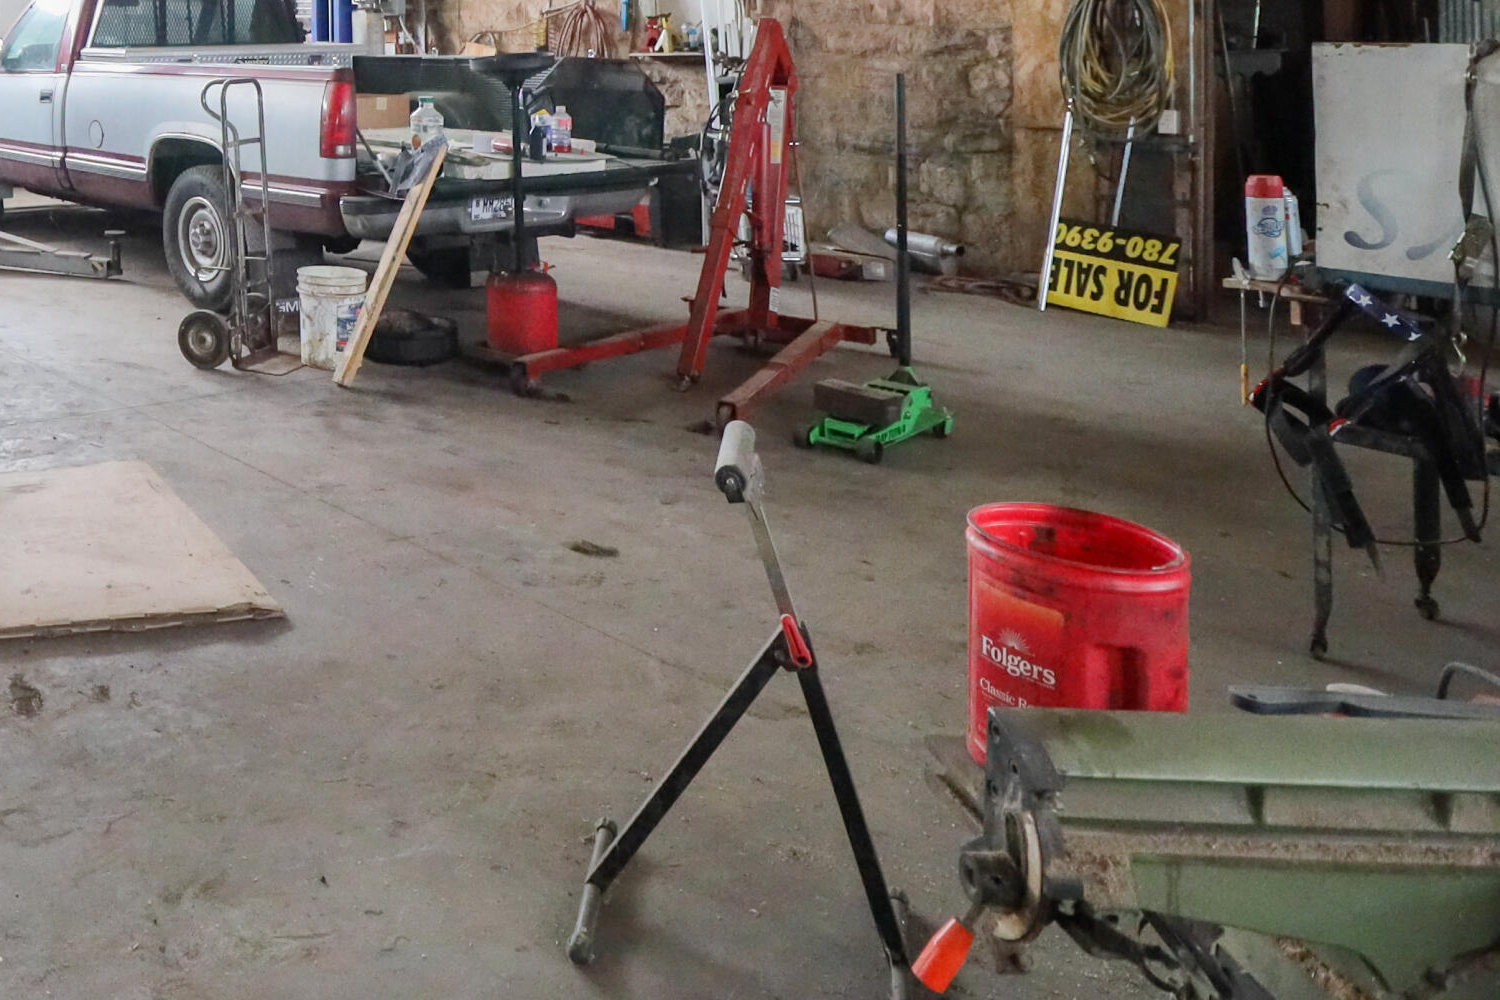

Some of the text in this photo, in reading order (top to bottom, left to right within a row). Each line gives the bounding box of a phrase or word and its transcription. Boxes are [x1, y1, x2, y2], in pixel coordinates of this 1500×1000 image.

[1049, 257, 1169, 315] FOR SALE
[981, 635, 1056, 686] Folgers
[979, 677, 1016, 704] Classic
